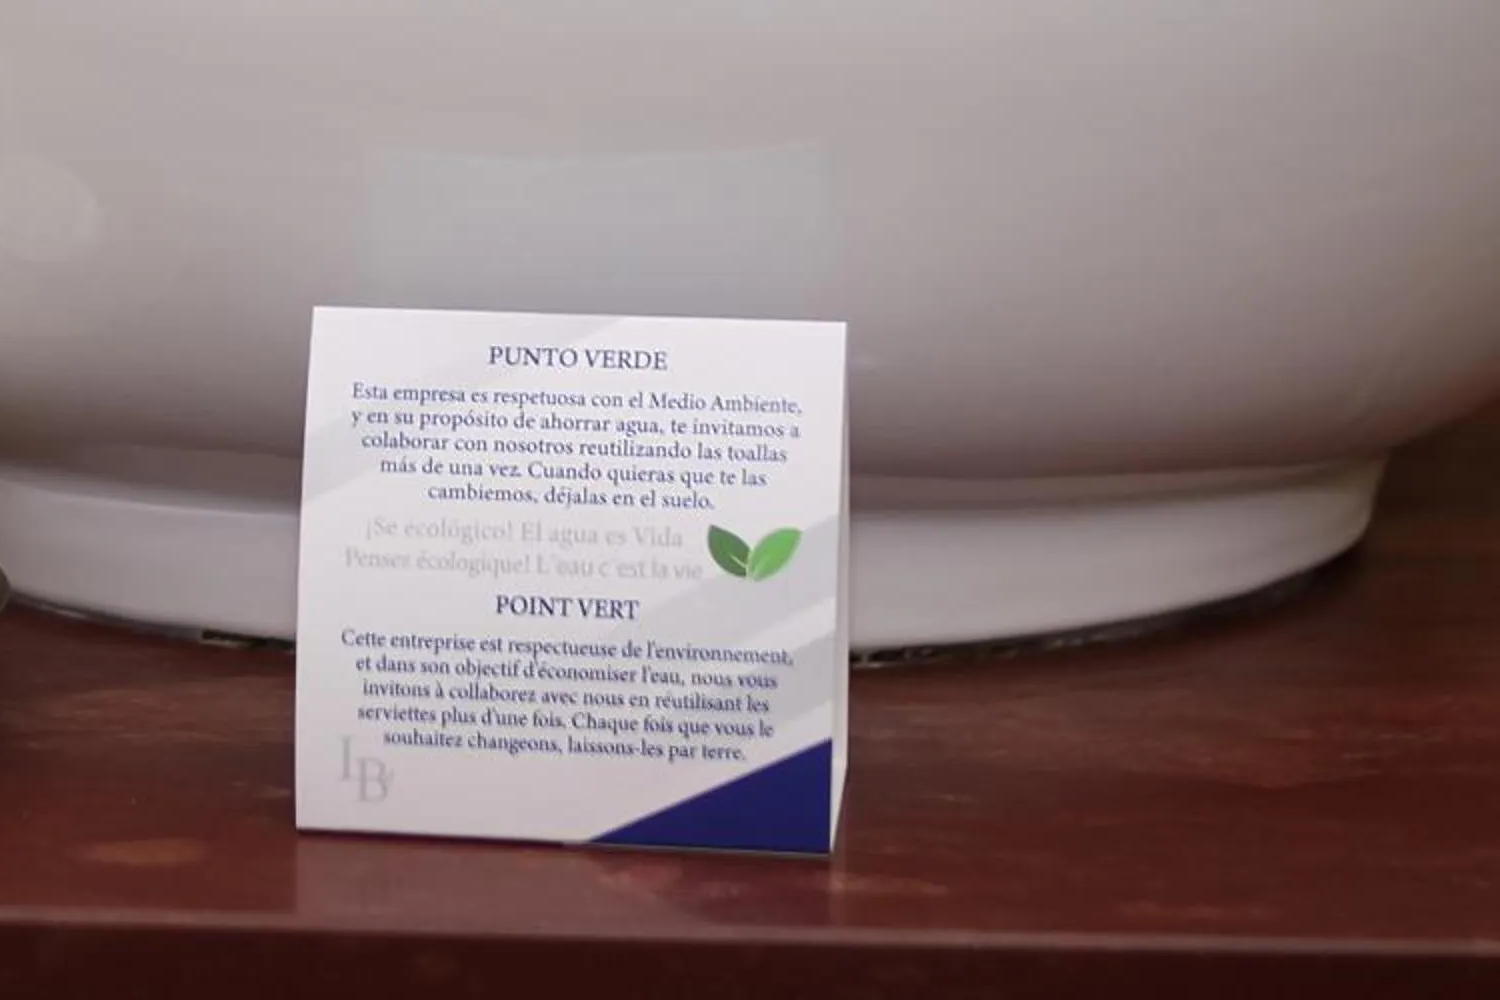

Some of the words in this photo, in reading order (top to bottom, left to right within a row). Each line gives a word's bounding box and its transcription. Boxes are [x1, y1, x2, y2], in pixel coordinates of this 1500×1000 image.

[489, 345, 578, 368] PUNTO
[585, 349, 668, 370] VERDE
[352, 381, 388, 400] Esta
[393, 386, 466, 406] empresa
[471, 390, 487, 403] es
[493, 391, 586, 408] respetuosa
[591, 393, 623, 408] con
[629, 392, 643, 408] el
[649, 392, 706, 410] Medio
[351, 410, 361, 427] y
[367, 411, 389, 424] en
[394, 411, 414, 425] su
[419, 409, 508, 431] propósito
[513, 412, 536, 429] de
[540, 413, 610, 433] ahorrar
[616, 420, 664, 436] agua,
[671, 420, 687, 434] te
[693, 418, 784, 438] invitamos
[790, 426, 800, 438] a
[361, 431, 448, 451] colaborar
[454, 438, 487, 451] con
[493, 438, 573, 455] nosotros
[579, 440, 691, 459] reutilizando
[697, 442, 722, 460] las
[728, 444, 788, 462] toallas
[380, 457, 416, 474] más
[421, 456, 443, 475] de
[449, 462, 482, 476] una
[528, 461, 602, 480] Cuando
[607, 466, 675, 486] quieras
[680, 471, 715, 489] que
[720, 470, 736, 485] te
[742, 469, 767, 486] las
[544, 486, 607, 509] déjalas
[612, 491, 634, 505] en
[640, 490, 656, 506] el
[522, 521, 542, 541] El
[548, 526, 598, 550] agua
[605, 530, 626, 545] es
[633, 525, 683, 547] Vida
[651, 557, 669, 578] la
[674, 562, 703, 579] vie
[496, 594, 573, 617] POINT
[578, 598, 640, 620] VERT
[341, 628, 386, 648] Cette
[390, 633, 475, 655] entreprise
[479, 637, 503, 653] est
[508, 638, 617, 659] respectueuse
[621, 640, 644, 658] de
[356, 656, 372, 672] et
[376, 654, 415, 673] dans
[420, 660, 450, 675] son
[455, 658, 519, 680] objectif
[691, 672, 732, 686] nous
[738, 675, 778, 689] vous
[363, 678, 431, 698] invitons
[435, 681, 444, 698] à
[449, 681, 535, 702] collaborez
[541, 690, 577, 704] avec
[583, 691, 624, 706] nous
[630, 693, 649, 708] en
[747, 695, 769, 713] les
[358, 704, 437, 722] serviettes
[441, 706, 476, 728] plus
[482, 707, 528, 727] d'une
[572, 712, 639, 735] Chaque
[643, 715, 673, 733] fois
[678, 721, 710, 739] que
[715, 724, 754, 738] vous
[759, 719, 774, 738] le
[384, 728, 463, 747] souhaitez
[467, 731, 563, 756] changeons,
[668, 743, 696, 764] par
[701, 744, 746, 761] terre.
